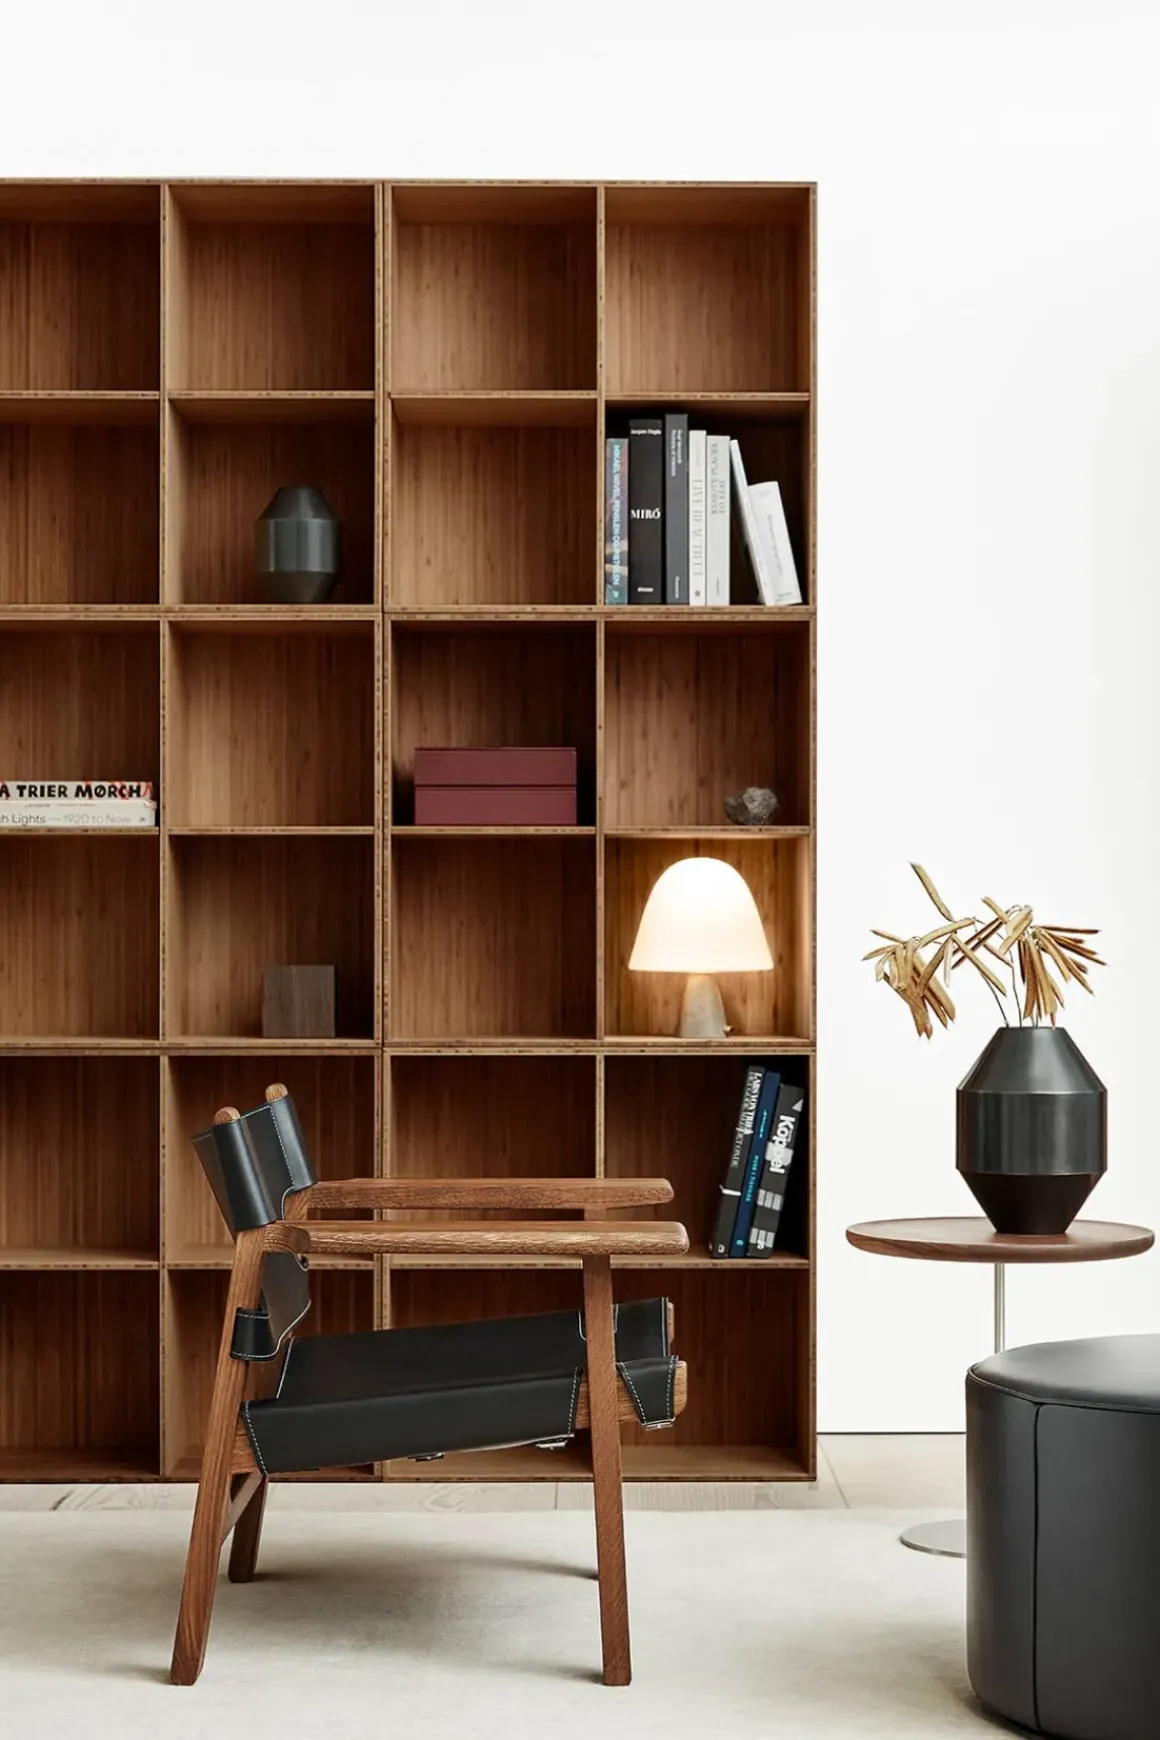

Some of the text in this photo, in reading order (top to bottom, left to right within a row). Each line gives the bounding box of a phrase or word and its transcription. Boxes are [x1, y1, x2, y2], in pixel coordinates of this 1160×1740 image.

[630, 507, 662, 520] MIRÓ
[16, 784, 68, 798] TRIER
[75, 784, 141, 798] MØRCH
[12, 813, 46, 826] Lights
[63, 814, 89, 824] 1920
[91, 814, 104, 824] to
[106, 814, 132, 824] Now
